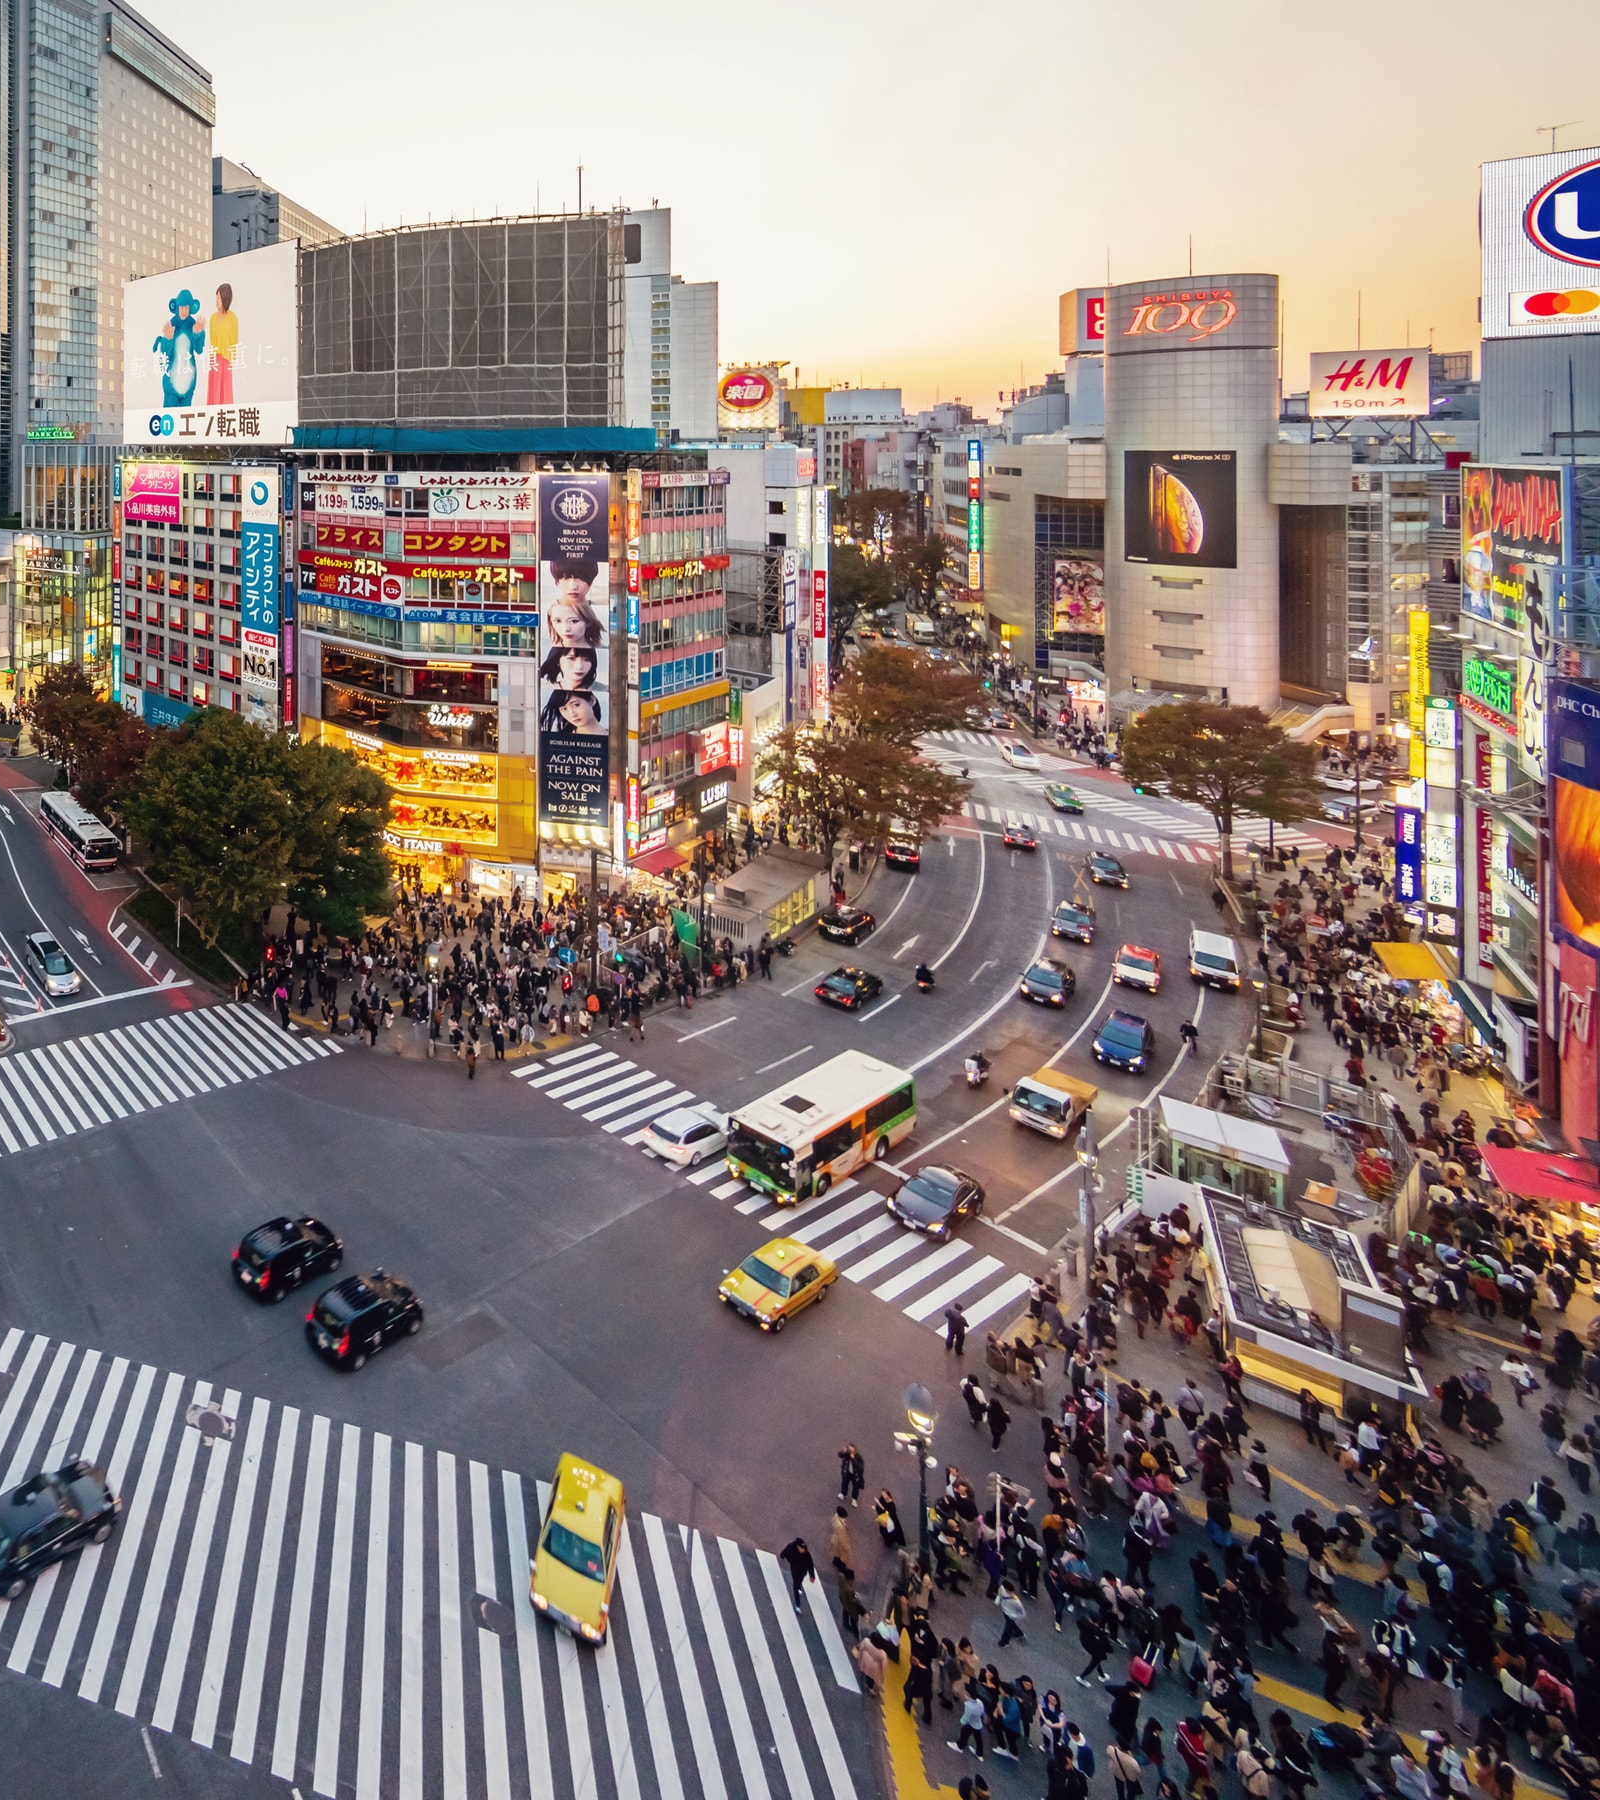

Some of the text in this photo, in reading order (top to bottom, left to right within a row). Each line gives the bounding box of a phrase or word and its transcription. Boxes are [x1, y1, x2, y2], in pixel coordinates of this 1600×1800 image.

[1143, 290, 1233, 304] SHIBUYA
[1123, 299, 1237, 342] 109
[1526, 313, 1598, 325] mastercard
[1323, 356, 1414, 393] H&M
[1332, 398, 1386, 409] 150m
[179, 407, 260, 438] エン転職
[147, 469, 177, 480] 品川スキン
[307, 473, 378, 485] しゃぶしゃぶバイキング
[419, 475, 530, 487] しゃぶしゃぶバイキング
[148, 480, 174, 490] クリニック
[303, 491, 315, 502] 9F
[318, 493, 348, 510] 1,199円
[351, 494, 384, 511] 1,599円
[465, 493, 532, 511] しゃぶ葉
[131, 502, 177, 518] 品川美容外科
[246, 507, 274, 519] eyecity
[1493, 472, 1562, 545] WANIMA
[318, 525, 382, 547] プライス
[405, 534, 507, 553] コンタクト
[54, 560, 81, 572] CITY
[354, 558, 388, 576] ガスト
[685, 559, 705, 577] ガスト
[245, 531, 260, 622] アイシティ
[262, 533, 274, 625] コンタクトの
[302, 570, 316, 583] 7F
[319, 573, 336, 583] Café
[412, 566, 524, 584] Caféレストラン ガスト
[337, 574, 378, 597] ガスト
[409, 610, 437, 619] AEON
[446, 611, 536, 625] 英会話イーオン
[243, 653, 277, 681] No.1
[242, 673, 277, 689] コンタクトショップ
[1415, 661, 1425, 706] Matsumoto
[1556, 695, 1580, 714] DHC
[423, 750, 480, 763] L'OCCITANE
[549, 754, 601, 766] AGAINST
[547, 764, 603, 777] THE PAIN
[548, 781, 600, 793] NOW ON
[701, 781, 728, 806] LUSH
[561, 791, 587, 801] SALE
